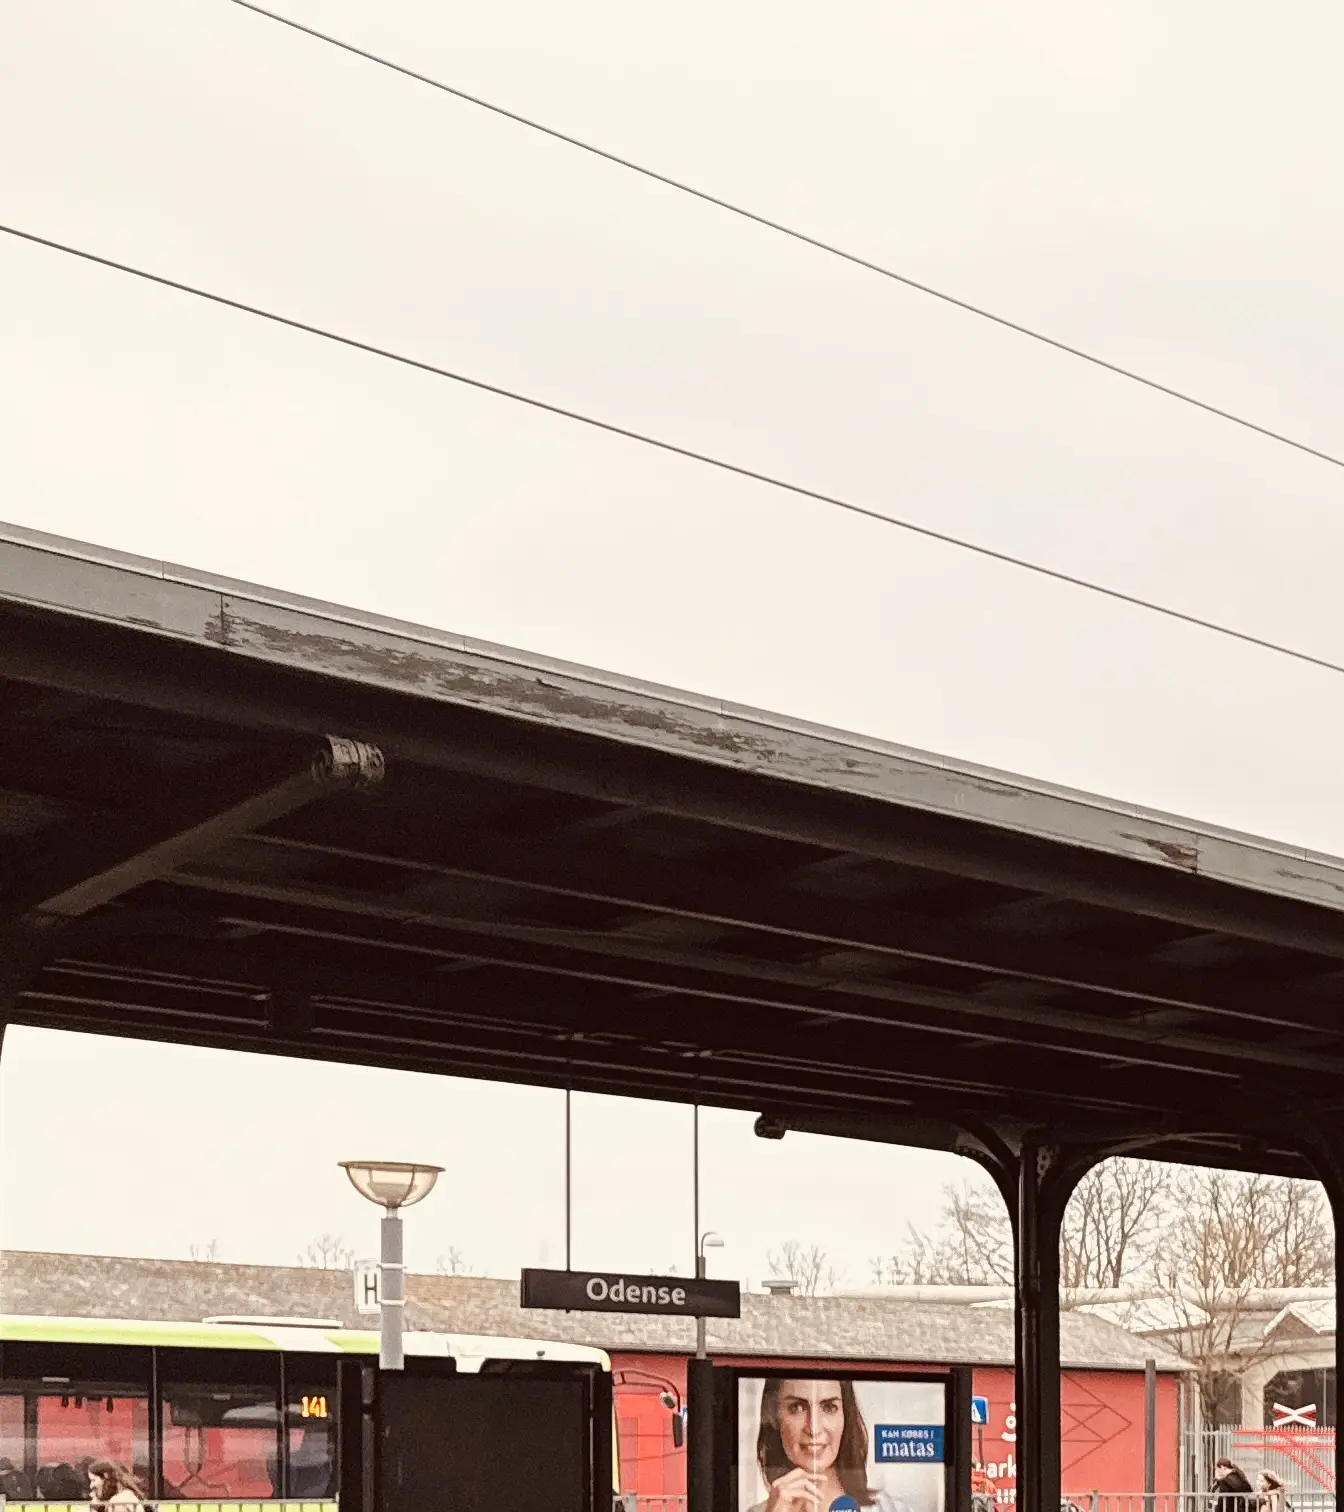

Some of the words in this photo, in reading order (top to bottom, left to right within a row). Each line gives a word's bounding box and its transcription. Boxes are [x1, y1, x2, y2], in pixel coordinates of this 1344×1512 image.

[364, 1273, 377, 1305] H
[586, 1277, 686, 1306] Odense
[301, 1396, 328, 1418] 141
[882, 1440, 935, 1458] matas
